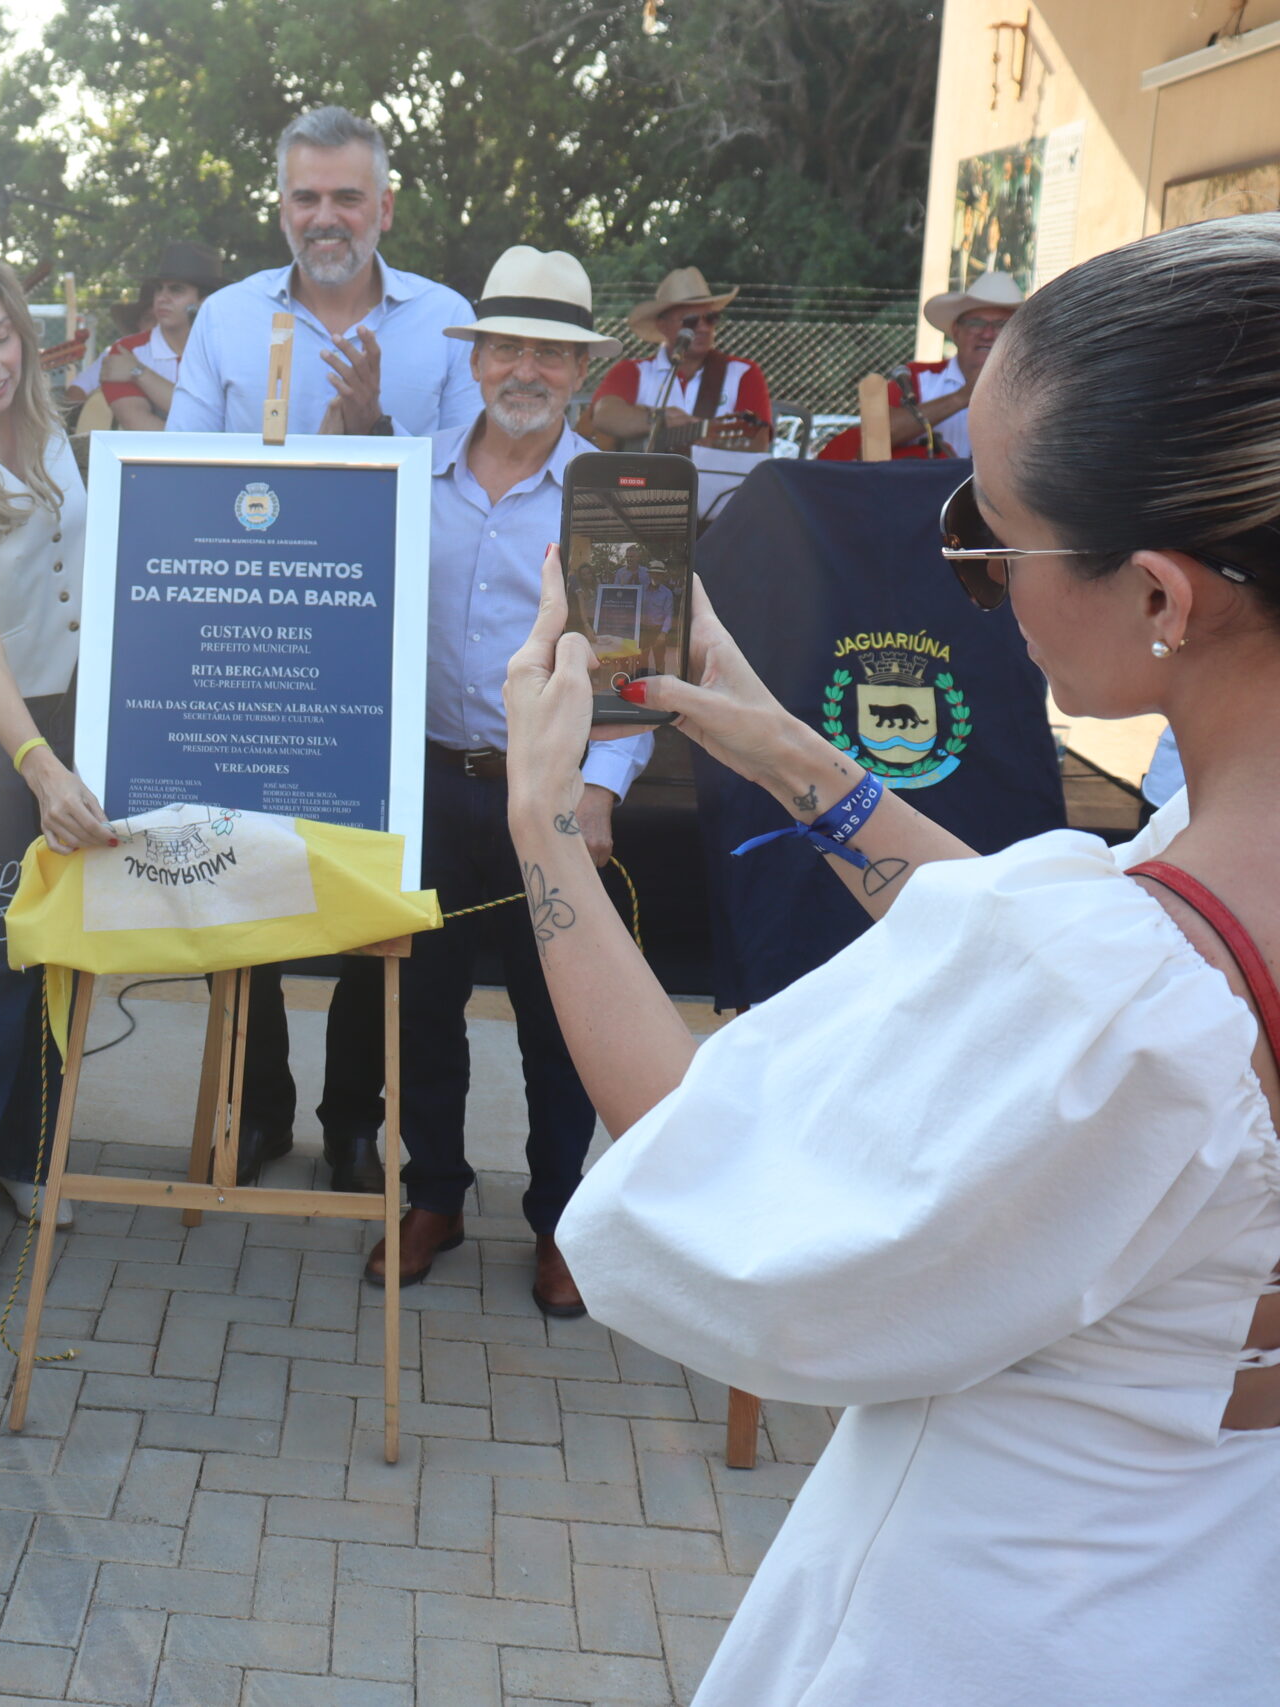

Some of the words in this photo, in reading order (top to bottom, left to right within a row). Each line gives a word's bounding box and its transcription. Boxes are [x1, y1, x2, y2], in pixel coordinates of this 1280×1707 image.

[146, 558, 230, 576] CENTRO
[235, 560, 263, 576] DE
[269, 561, 364, 579] EVENTOS
[131, 585, 160, 602] DA
[166, 586, 263, 604] FAZENDA
[269, 589, 299, 605] DA
[304, 590, 377, 608] BARRA
[200, 624, 273, 640] GUSTAVO
[276, 626, 313, 641] REIS
[200, 642, 250, 653] PREFEITO
[252, 643, 312, 654] MUNICIPAL
[833, 629, 951, 663] JAGUARIÚNA
[191, 664, 223, 676] RITA
[225, 665, 320, 679] BERGAMASCO
[193, 678, 262, 690] VICE-PREFEITA
[264, 680, 317, 691] MUNICIPAL
[125, 699, 163, 710] MARIA
[165, 700, 188, 710] DAS
[189, 700, 235, 713] GRAÇAS
[237, 701, 283, 713] HANSEN
[284, 703, 338, 714] ALBARAN
[339, 705, 384, 716] SANTOS
[232, 713, 243, 722] DE
[244, 713, 281, 723] TURISMO
[281, 714, 287, 723] E
[288, 714, 325, 724] CULTURA
[168, 732, 228, 744] ROMILSON
[230, 733, 305, 746] NASCIMENTO
[306, 735, 338, 747] SILVA
[182, 744, 230, 754] PRESIDENTE
[230, 745, 242, 754] DA
[242, 744, 278, 756] CÂMARA
[278, 747, 323, 757] MUNICIPAL
[214, 762, 290, 775] VEREADORES
[862, 787, 878, 809] DO
